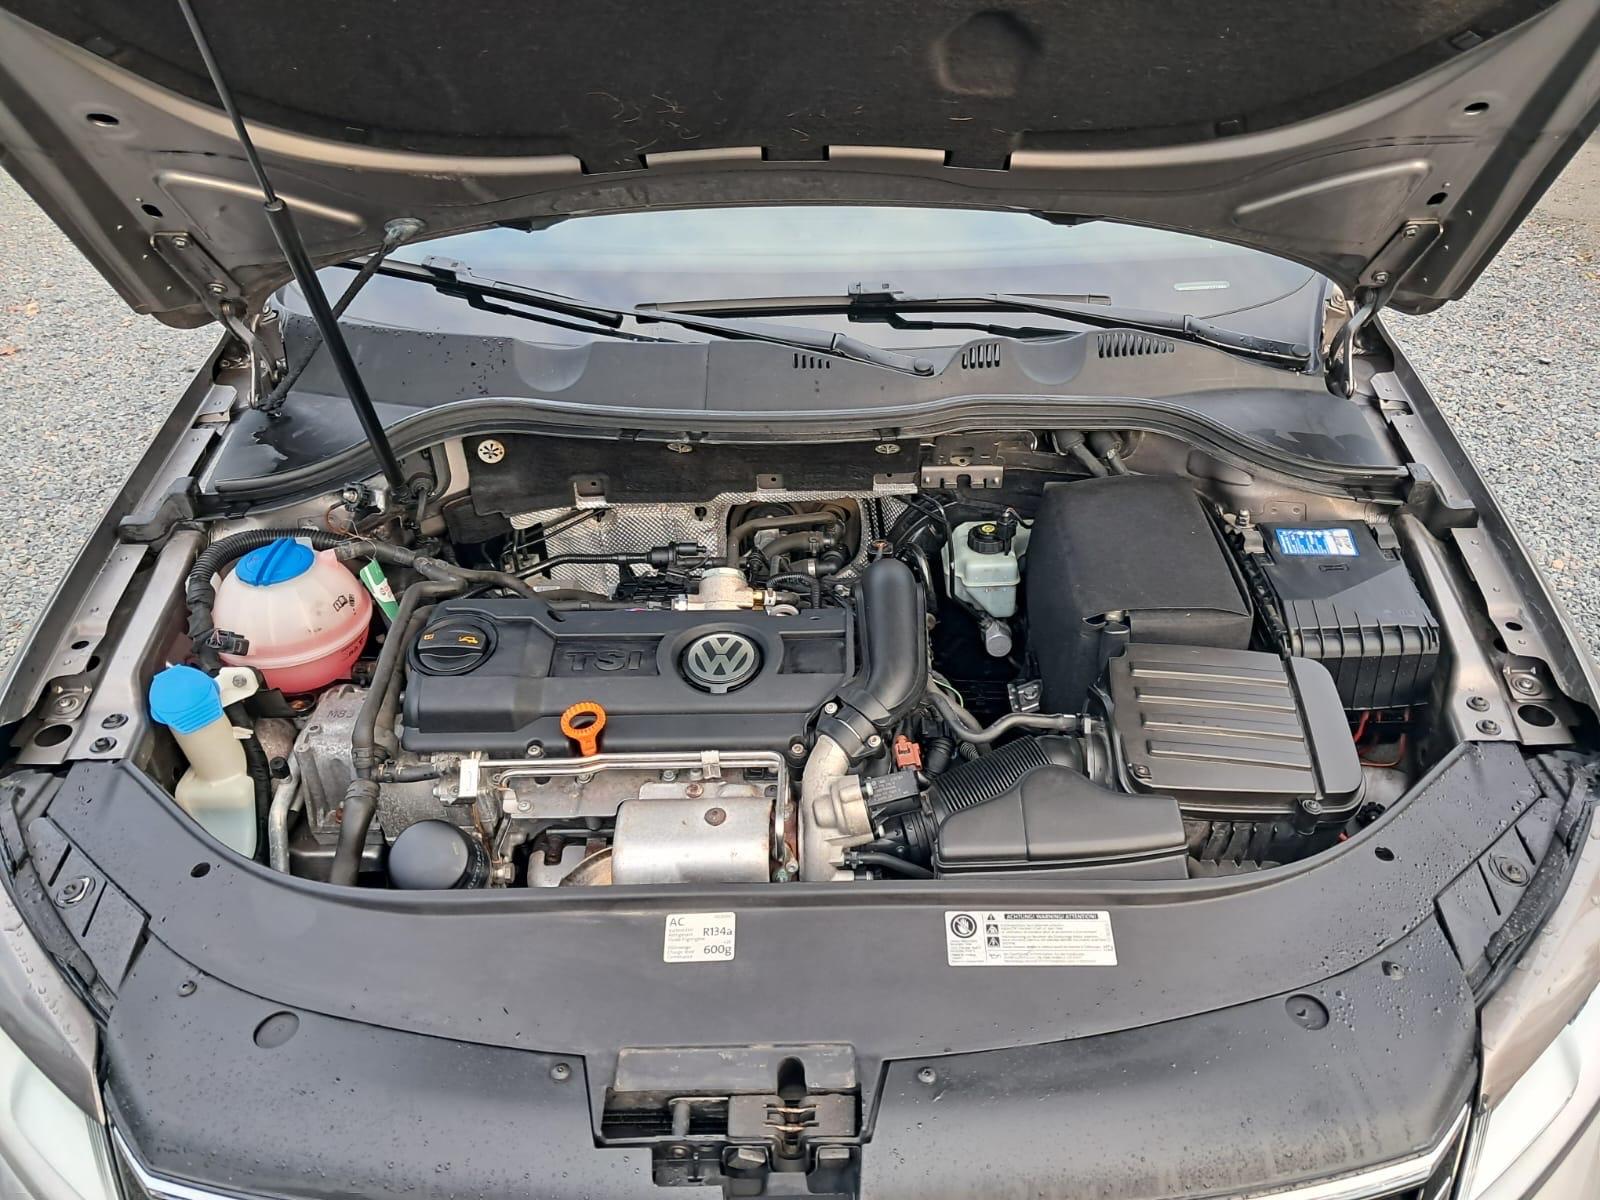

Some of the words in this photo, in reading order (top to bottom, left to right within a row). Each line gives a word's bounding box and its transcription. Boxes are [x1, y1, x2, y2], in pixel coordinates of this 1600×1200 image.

[565, 649, 645, 671] TSI
[669, 917, 686, 927] AC
[703, 927, 733, 936] R134a
[703, 945, 732, 956] 600g
